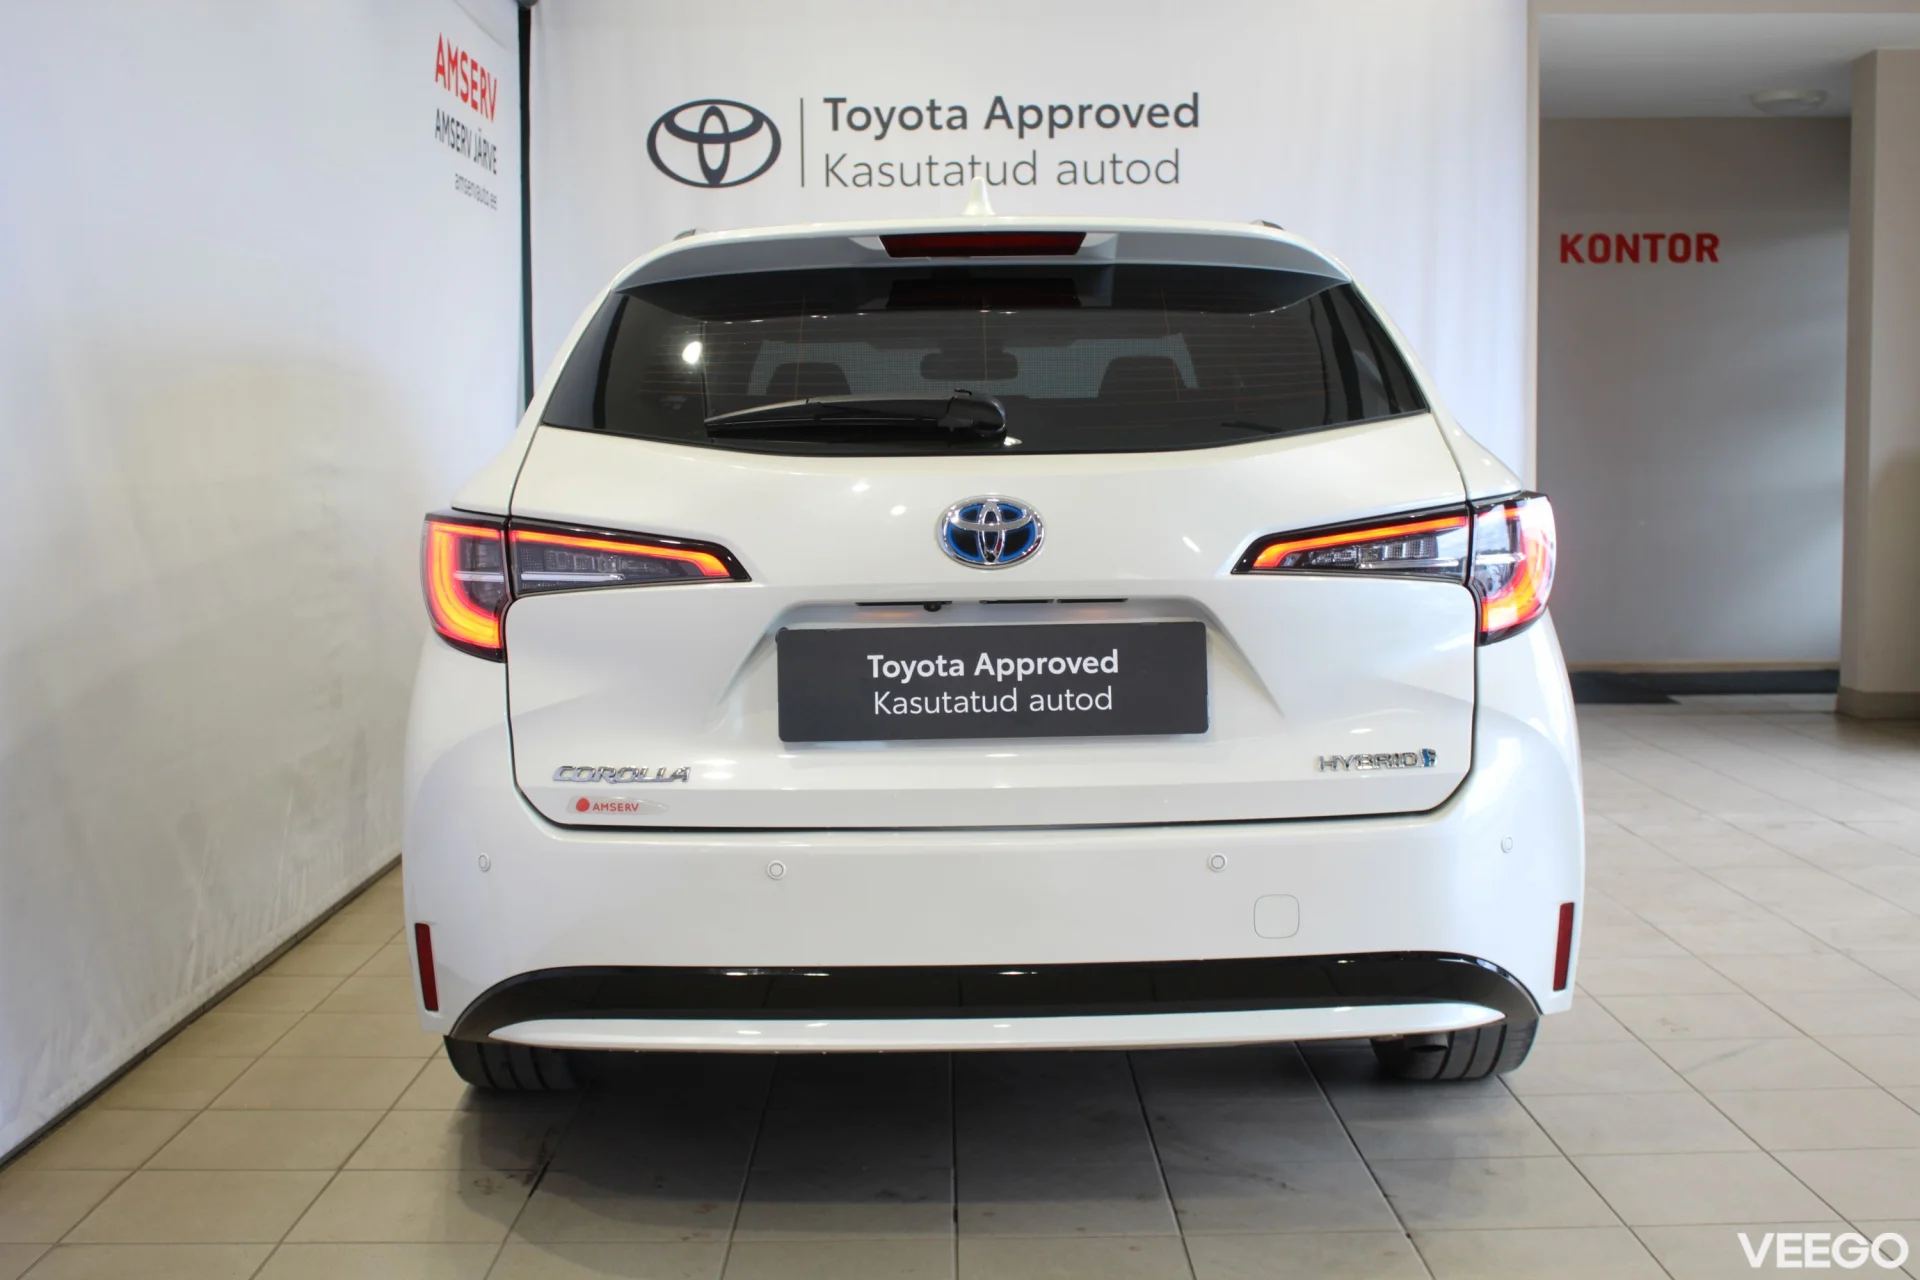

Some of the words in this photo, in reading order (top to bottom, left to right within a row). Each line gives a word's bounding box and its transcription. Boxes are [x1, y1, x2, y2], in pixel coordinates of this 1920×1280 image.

[435, 32, 497, 123] AMSERV
[823, 97, 969, 140] Toyota
[983, 92, 1200, 139] Approved
[435, 108, 472, 159] AMSERV
[473, 127, 497, 175] JÄRVE
[823, 149, 1037, 188] Kasutatud
[1056, 148, 1180, 186] autod
[1560, 233, 1720, 264] KONTOR
[867, 654, 965, 683] Toyota
[974, 649, 1119, 681] Approved
[873, 687, 1018, 715] Kasutatud
[1029, 686, 1112, 712] autod
[553, 765, 691, 784] COROLLA
[1318, 752, 1418, 771] HYBRID
[592, 802, 640, 812] AMSERV
